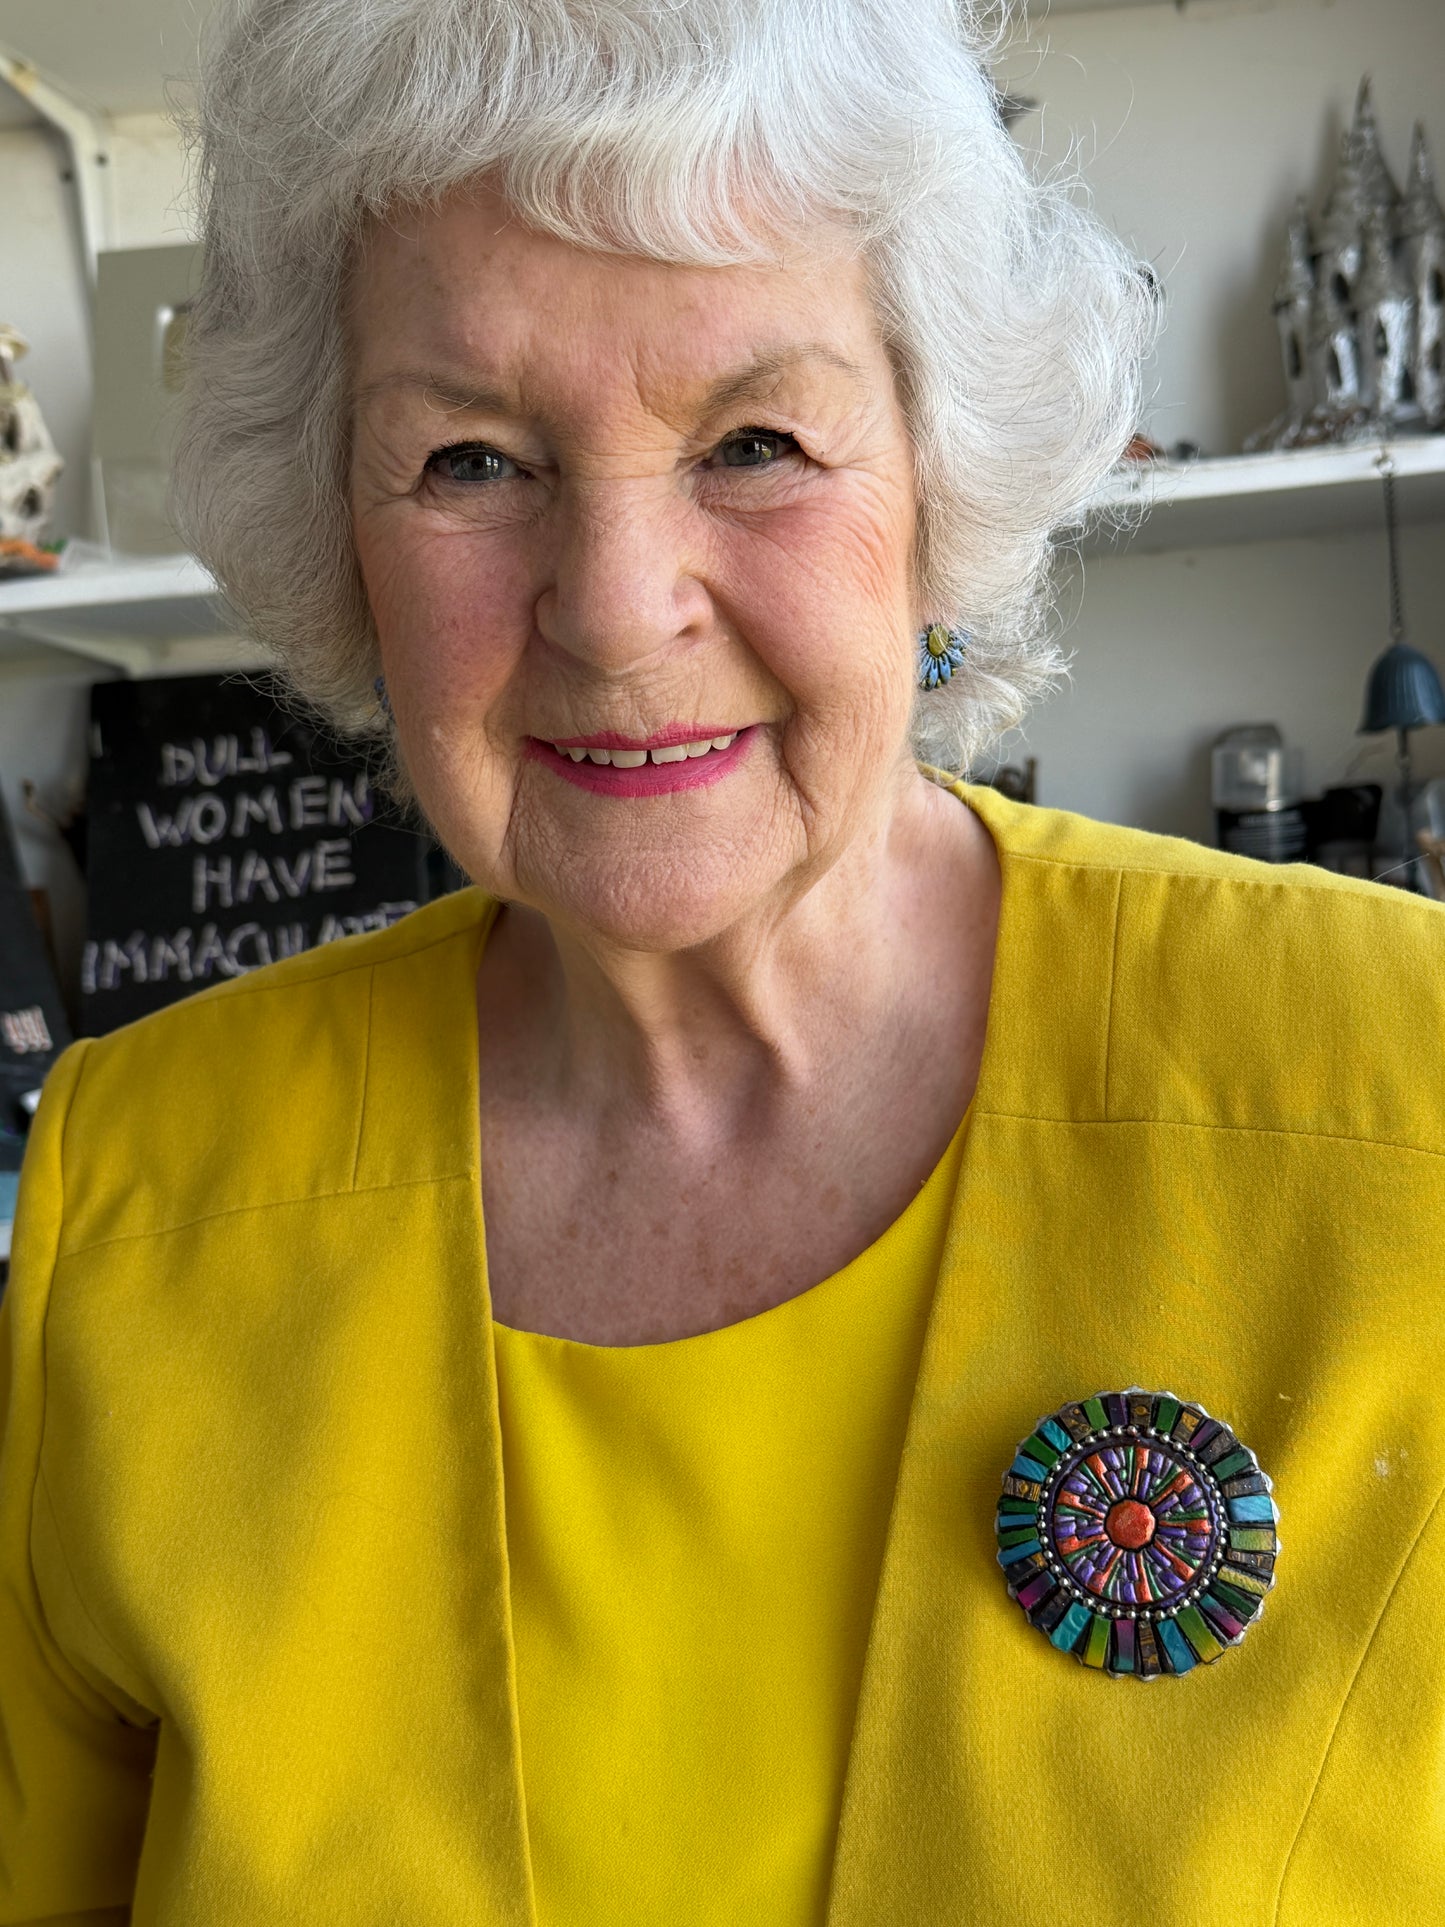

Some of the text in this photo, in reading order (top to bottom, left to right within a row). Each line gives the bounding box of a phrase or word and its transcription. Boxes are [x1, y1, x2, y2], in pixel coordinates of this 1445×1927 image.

[161, 726, 293, 786] DULL
[137, 773, 370, 849] WOMEN
[193, 838, 357, 914] HAVE
